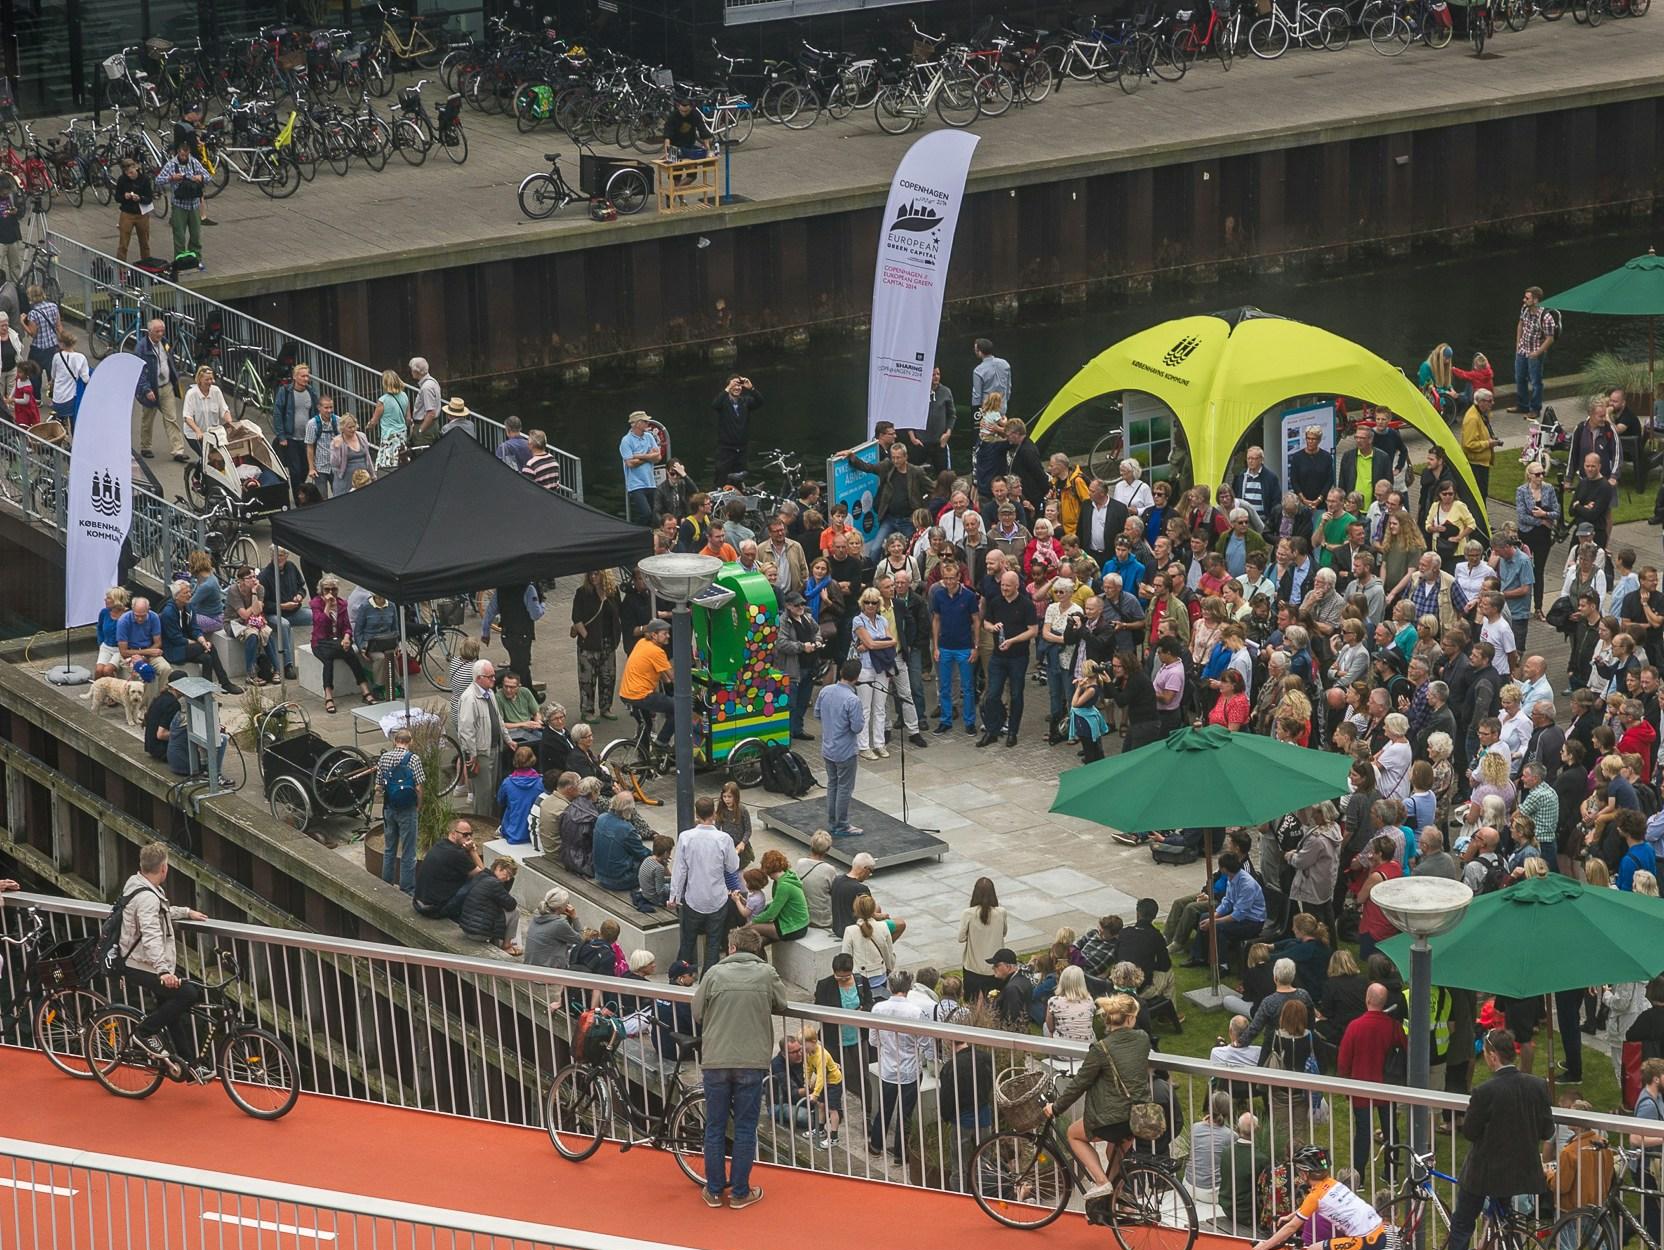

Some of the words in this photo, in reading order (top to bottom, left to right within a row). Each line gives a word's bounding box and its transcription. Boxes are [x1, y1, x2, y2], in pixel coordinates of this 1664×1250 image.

[899, 179, 949, 200] COPENHAGEN
[887, 233, 938, 253] EUROPEAN
[887, 242, 908, 252] GREEN
[910, 248, 936, 260] CAPITAL
[883, 271, 912, 283] EUROPEAN
[914, 278, 933, 287] GREEN
[884, 265, 922, 279] COPENHAGEN
[882, 278, 904, 287] CAPITAL
[905, 282, 917, 290] 2014
[896, 362, 923, 372] SHARING
[1165, 373, 1190, 387] KOMMUNE
